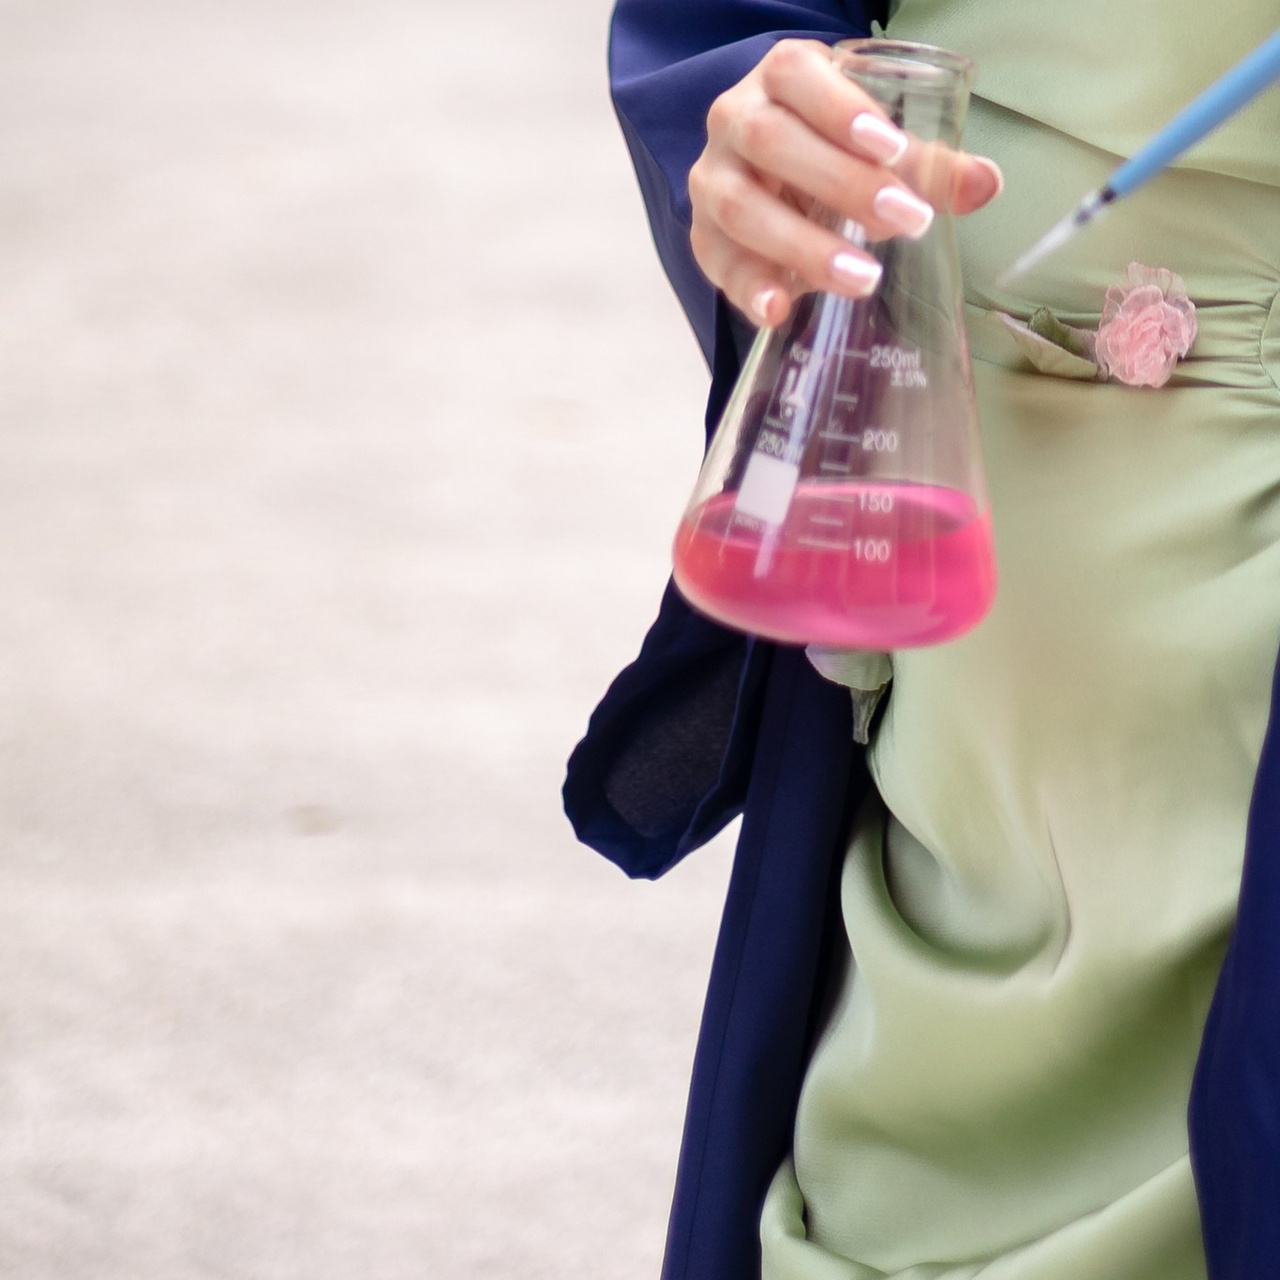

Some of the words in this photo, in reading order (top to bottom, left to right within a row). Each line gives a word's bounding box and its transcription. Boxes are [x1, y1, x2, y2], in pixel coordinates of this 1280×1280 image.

[870, 345, 922, 370] 250ml
[862, 429, 899, 453] 200
[859, 490, 893, 514] 150
[855, 538, 890, 563] 100
